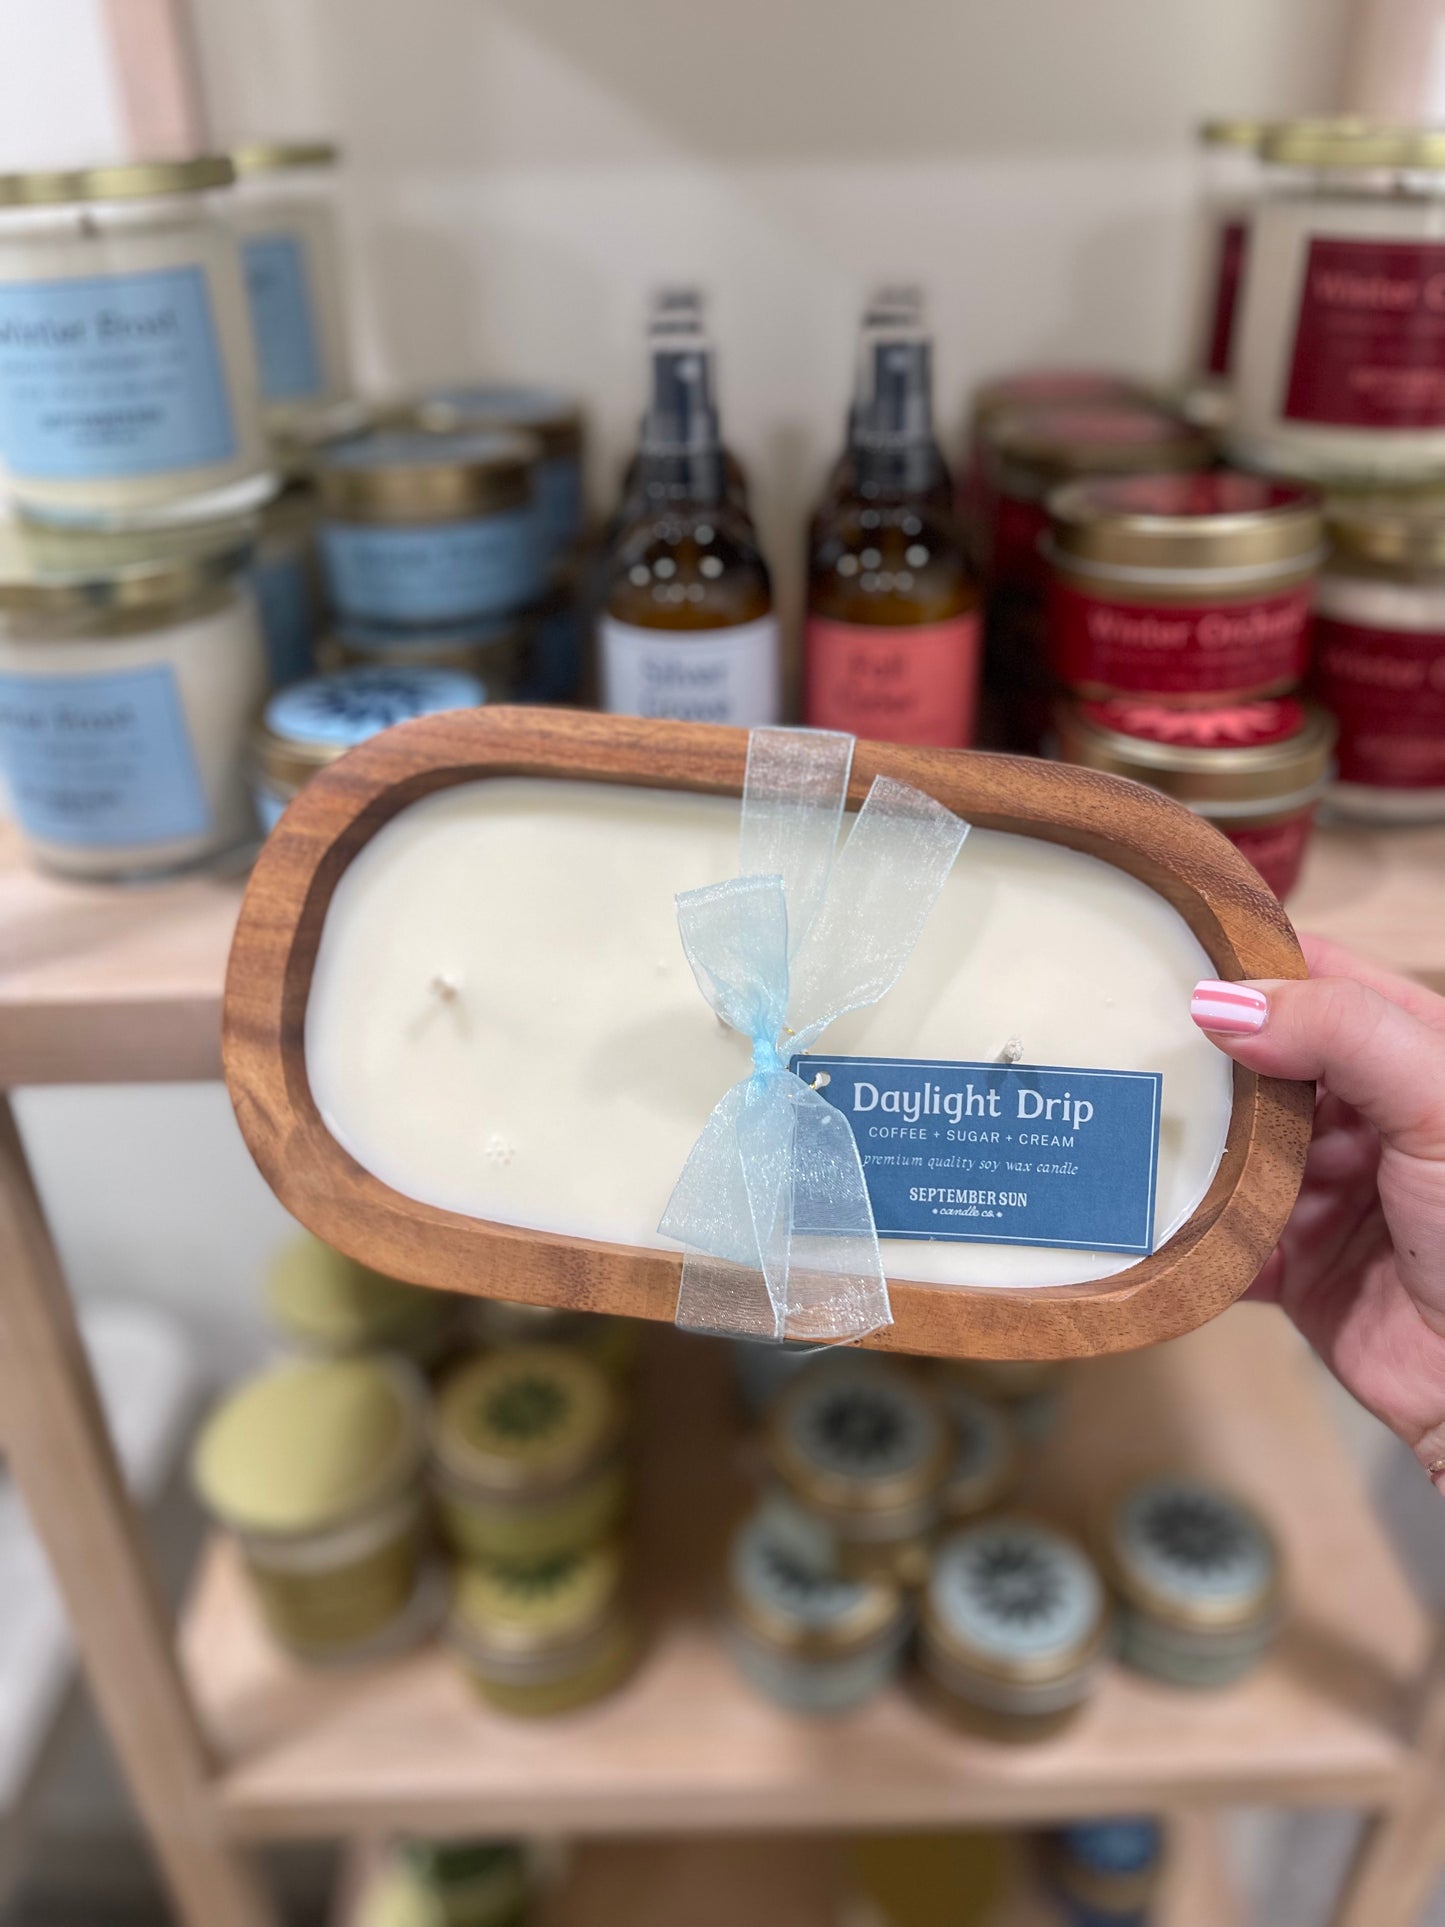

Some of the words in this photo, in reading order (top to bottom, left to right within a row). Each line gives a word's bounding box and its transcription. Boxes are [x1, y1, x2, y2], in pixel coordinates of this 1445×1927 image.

[1087, 607, 1190, 649] Winter
[853, 1082, 1002, 1124] Daylight
[1016, 1089, 1094, 1130] Drip
[868, 1126, 927, 1140] COFFEE
[946, 1130, 1000, 1143] SUGAR
[1018, 1133, 1075, 1148] CREAM
[862, 1154, 923, 1167] premium
[928, 1156, 975, 1173] quality
[979, 1160, 1000, 1173] soy
[1005, 1161, 1032, 1172] wax
[1036, 1161, 1079, 1175] candle
[909, 1187, 997, 1206] SEPTEMBER
[998, 1192, 1028, 1207] SUN
[939, 1206, 980, 1217] candle
